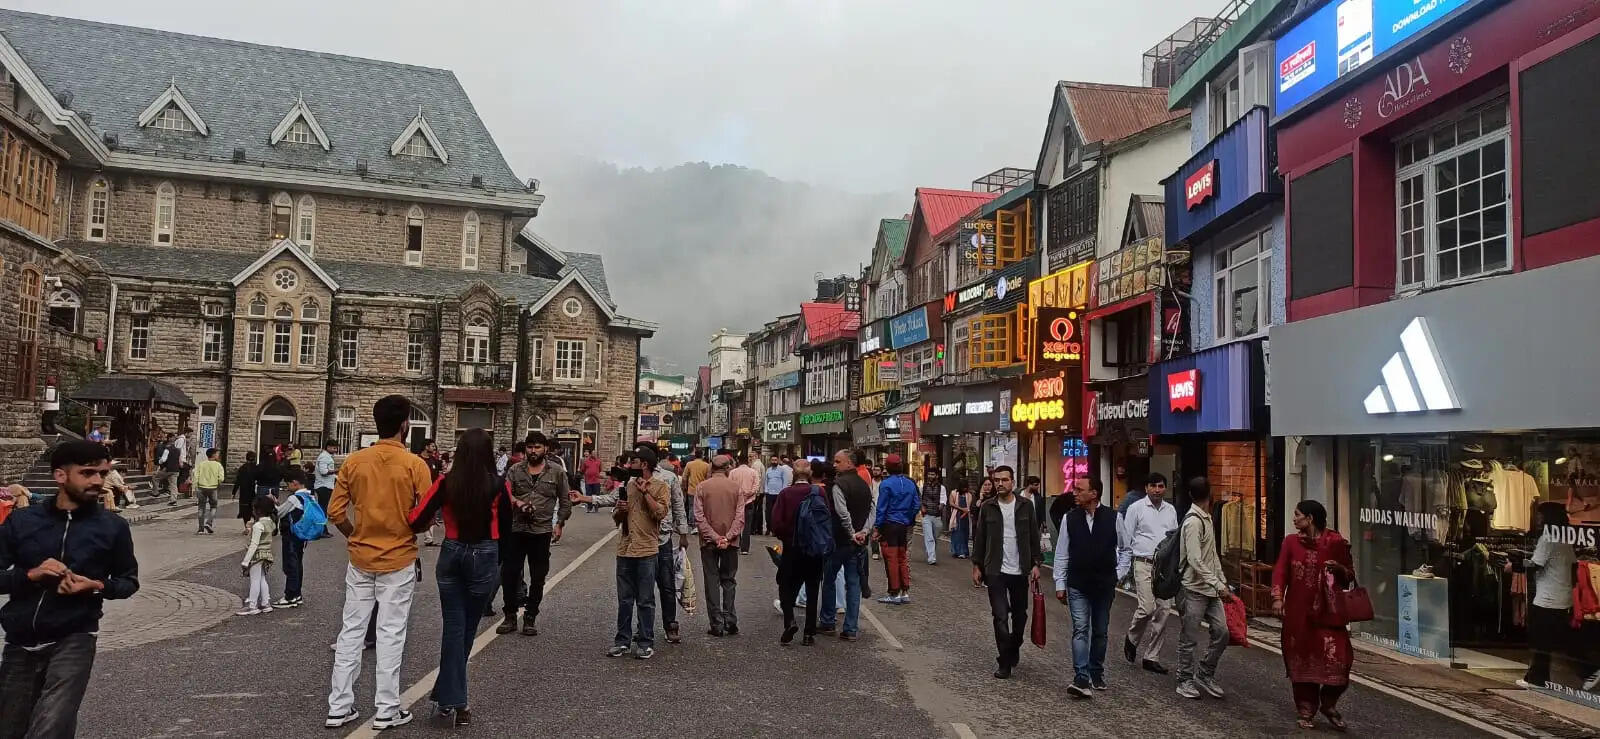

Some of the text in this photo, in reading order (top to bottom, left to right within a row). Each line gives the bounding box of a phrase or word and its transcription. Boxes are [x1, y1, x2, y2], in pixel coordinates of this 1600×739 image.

[1392, 0, 1437, 33] DOWNLOAD
[1380, 56, 1430, 110] ADA
[959, 282, 985, 303] WILDCRAFT
[1043, 342, 1080, 354] xero
[1043, 352, 1080, 361] degrees
[933, 402, 961, 417] WILDCRAFT
[1012, 398, 1064, 430] degrees
[1097, 401, 1127, 421] Hideout
[767, 420, 792, 431] OCTAVE
[1360, 508, 1438, 529] ADIDAS WALKING
[1542, 523, 1596, 547] ADIDAS
[1544, 680, 1574, 696] STEP-IN
[1575, 689, 1592, 702] AND
